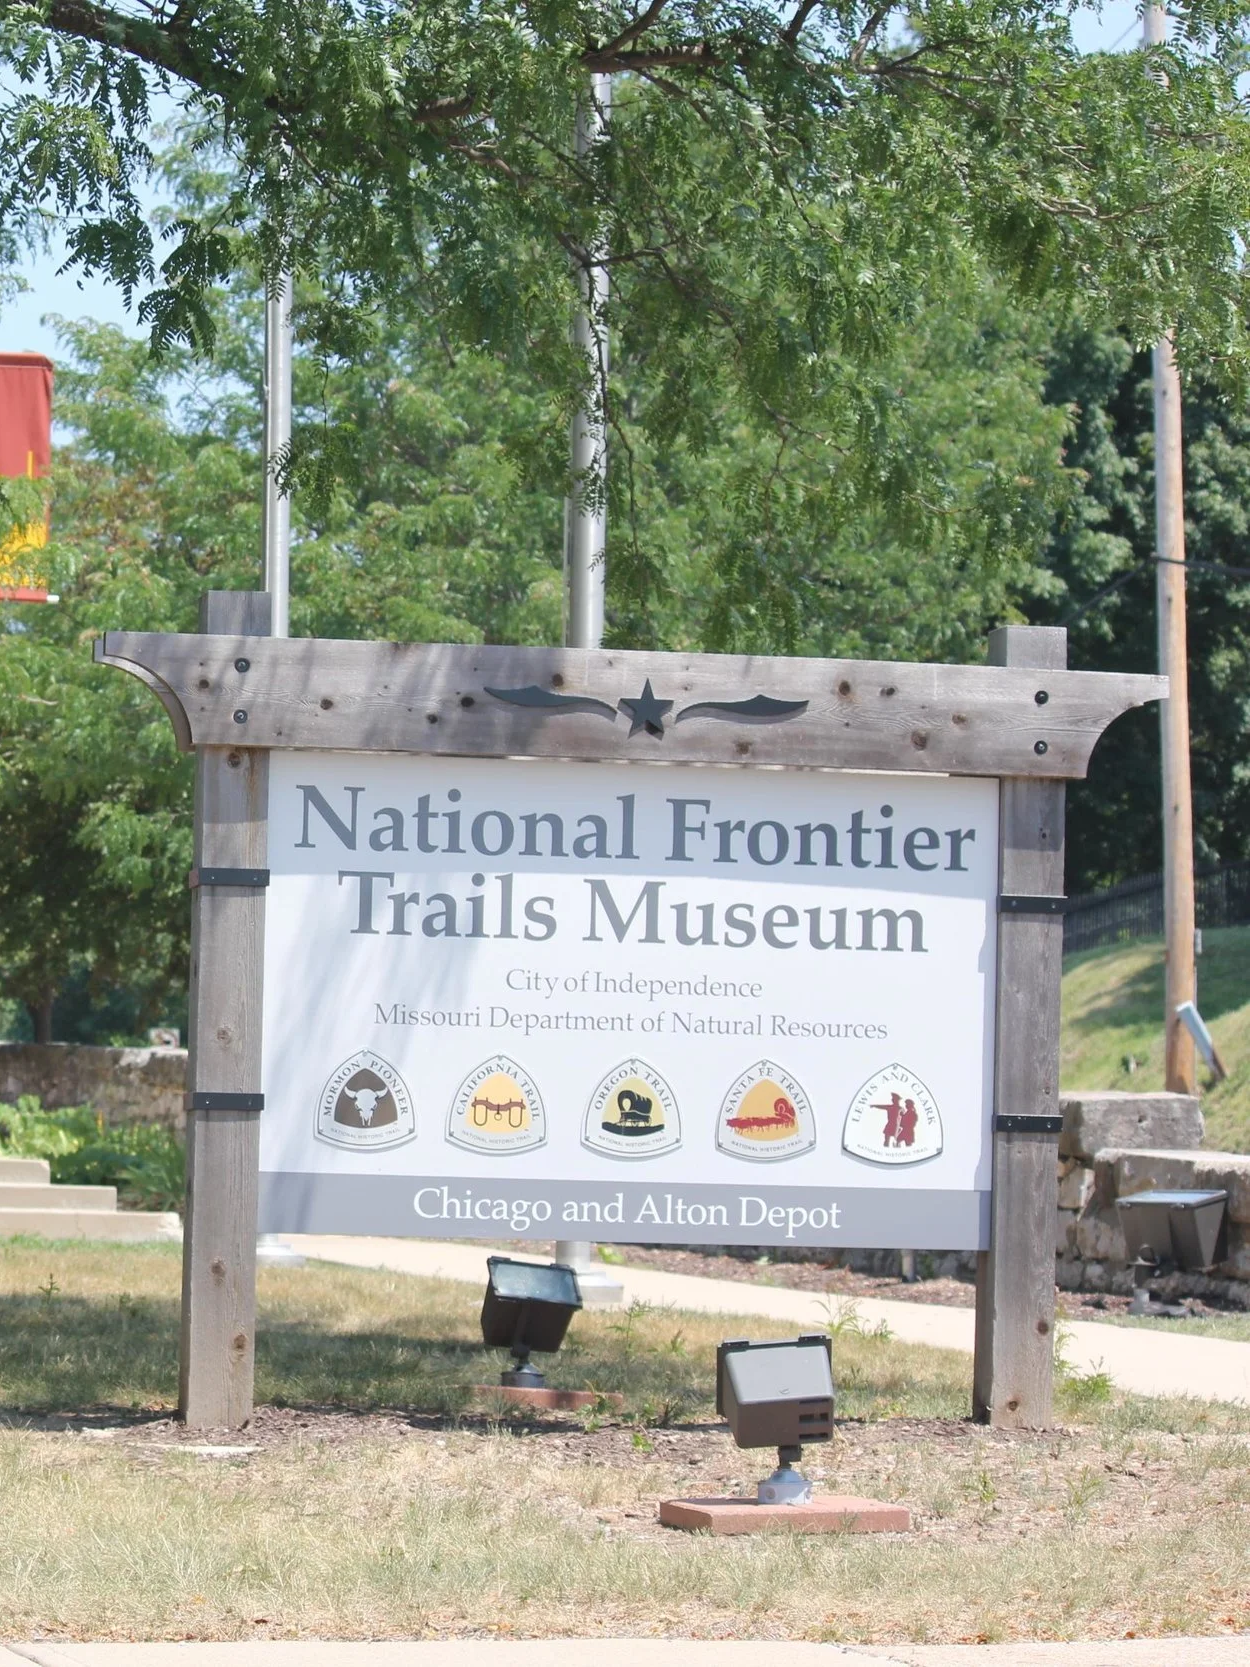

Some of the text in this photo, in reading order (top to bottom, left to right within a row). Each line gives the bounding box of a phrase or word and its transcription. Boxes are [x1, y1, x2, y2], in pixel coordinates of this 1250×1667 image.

[293, 784, 976, 872] National Frontier
[338, 870, 929, 953] Trails Museum
[505, 968, 763, 1001] City of Independence
[373, 1003, 889, 1040] Missouri Department of Natural Resources
[323, 1060, 409, 1117] MORMON PIONEER
[456, 1063, 541, 1122] CALIFORNIA TRAIL
[594, 1065, 672, 1112] OREGON TRAIL
[725, 1066, 808, 1115] SANTA FE TRAIL
[852, 1071, 937, 1126] LEWIS AND CLARK
[413, 1186, 842, 1239] Chicago and Alton Depot
